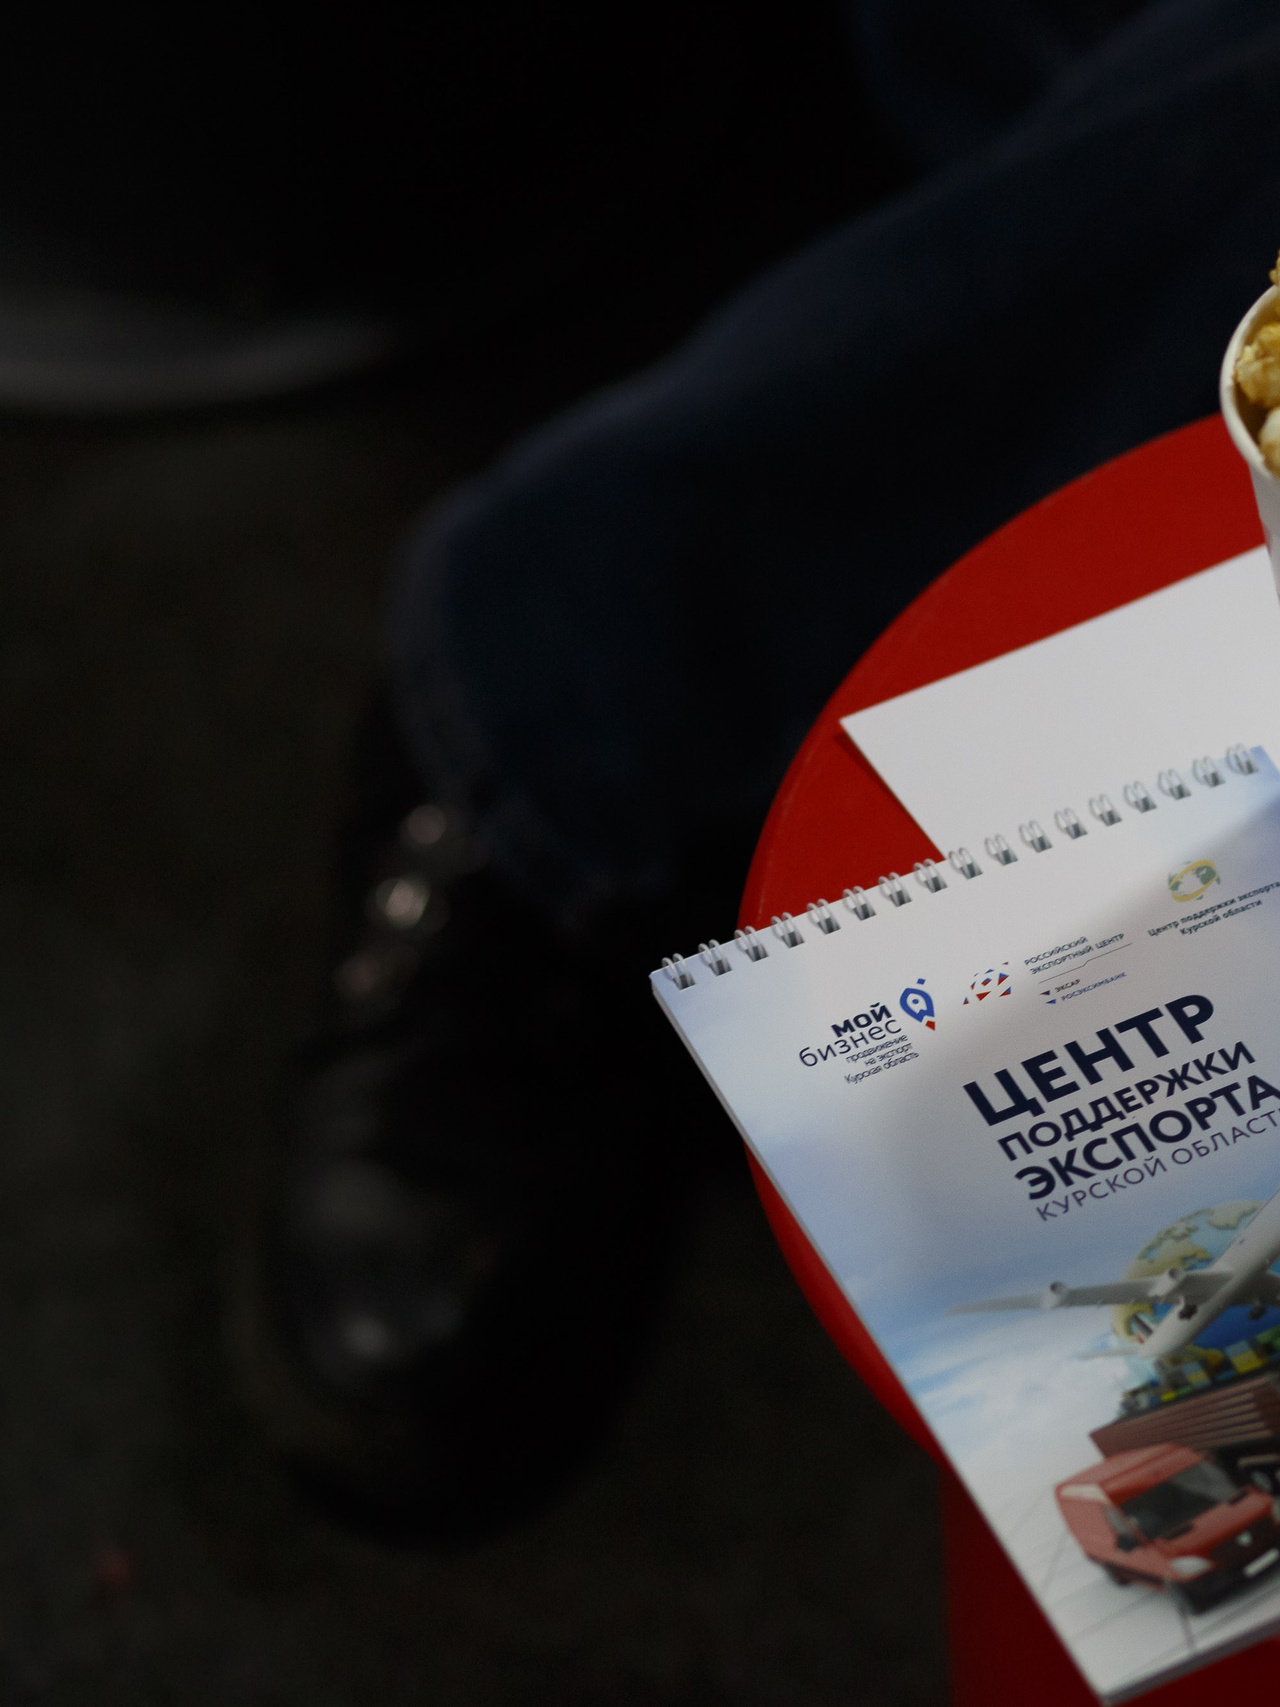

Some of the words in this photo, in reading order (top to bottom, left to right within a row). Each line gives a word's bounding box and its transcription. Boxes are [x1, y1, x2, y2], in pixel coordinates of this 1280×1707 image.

[1147, 917, 1180, 938] Центр
[1180, 896, 1236, 925] поддержки
[1236, 881, 1280, 904] экспорта
[1180, 913, 1222, 936] Курской
[1222, 899, 1263, 921] области
[1024, 935, 1089, 967] РОССИЙСКИЙ
[1029, 945, 1095, 976] ЭКСПОРТНЫЙ
[1095, 932, 1126, 951] ЦЕНТР
[799, 1018, 903, 1068] бизнес
[846, 1033, 909, 1064] продвижение
[864, 1054, 878, 1067] на
[878, 1042, 914, 1062] экспорт
[963, 994, 1214, 1127] ЦЕНТР
[844, 1064, 883, 1084] Курская
[883, 1050, 920, 1071] область
[997, 1041, 1257, 1161] ПОДДЕРЖКИ
[1036, 1155, 1168, 1222] КУРСКОЙ
